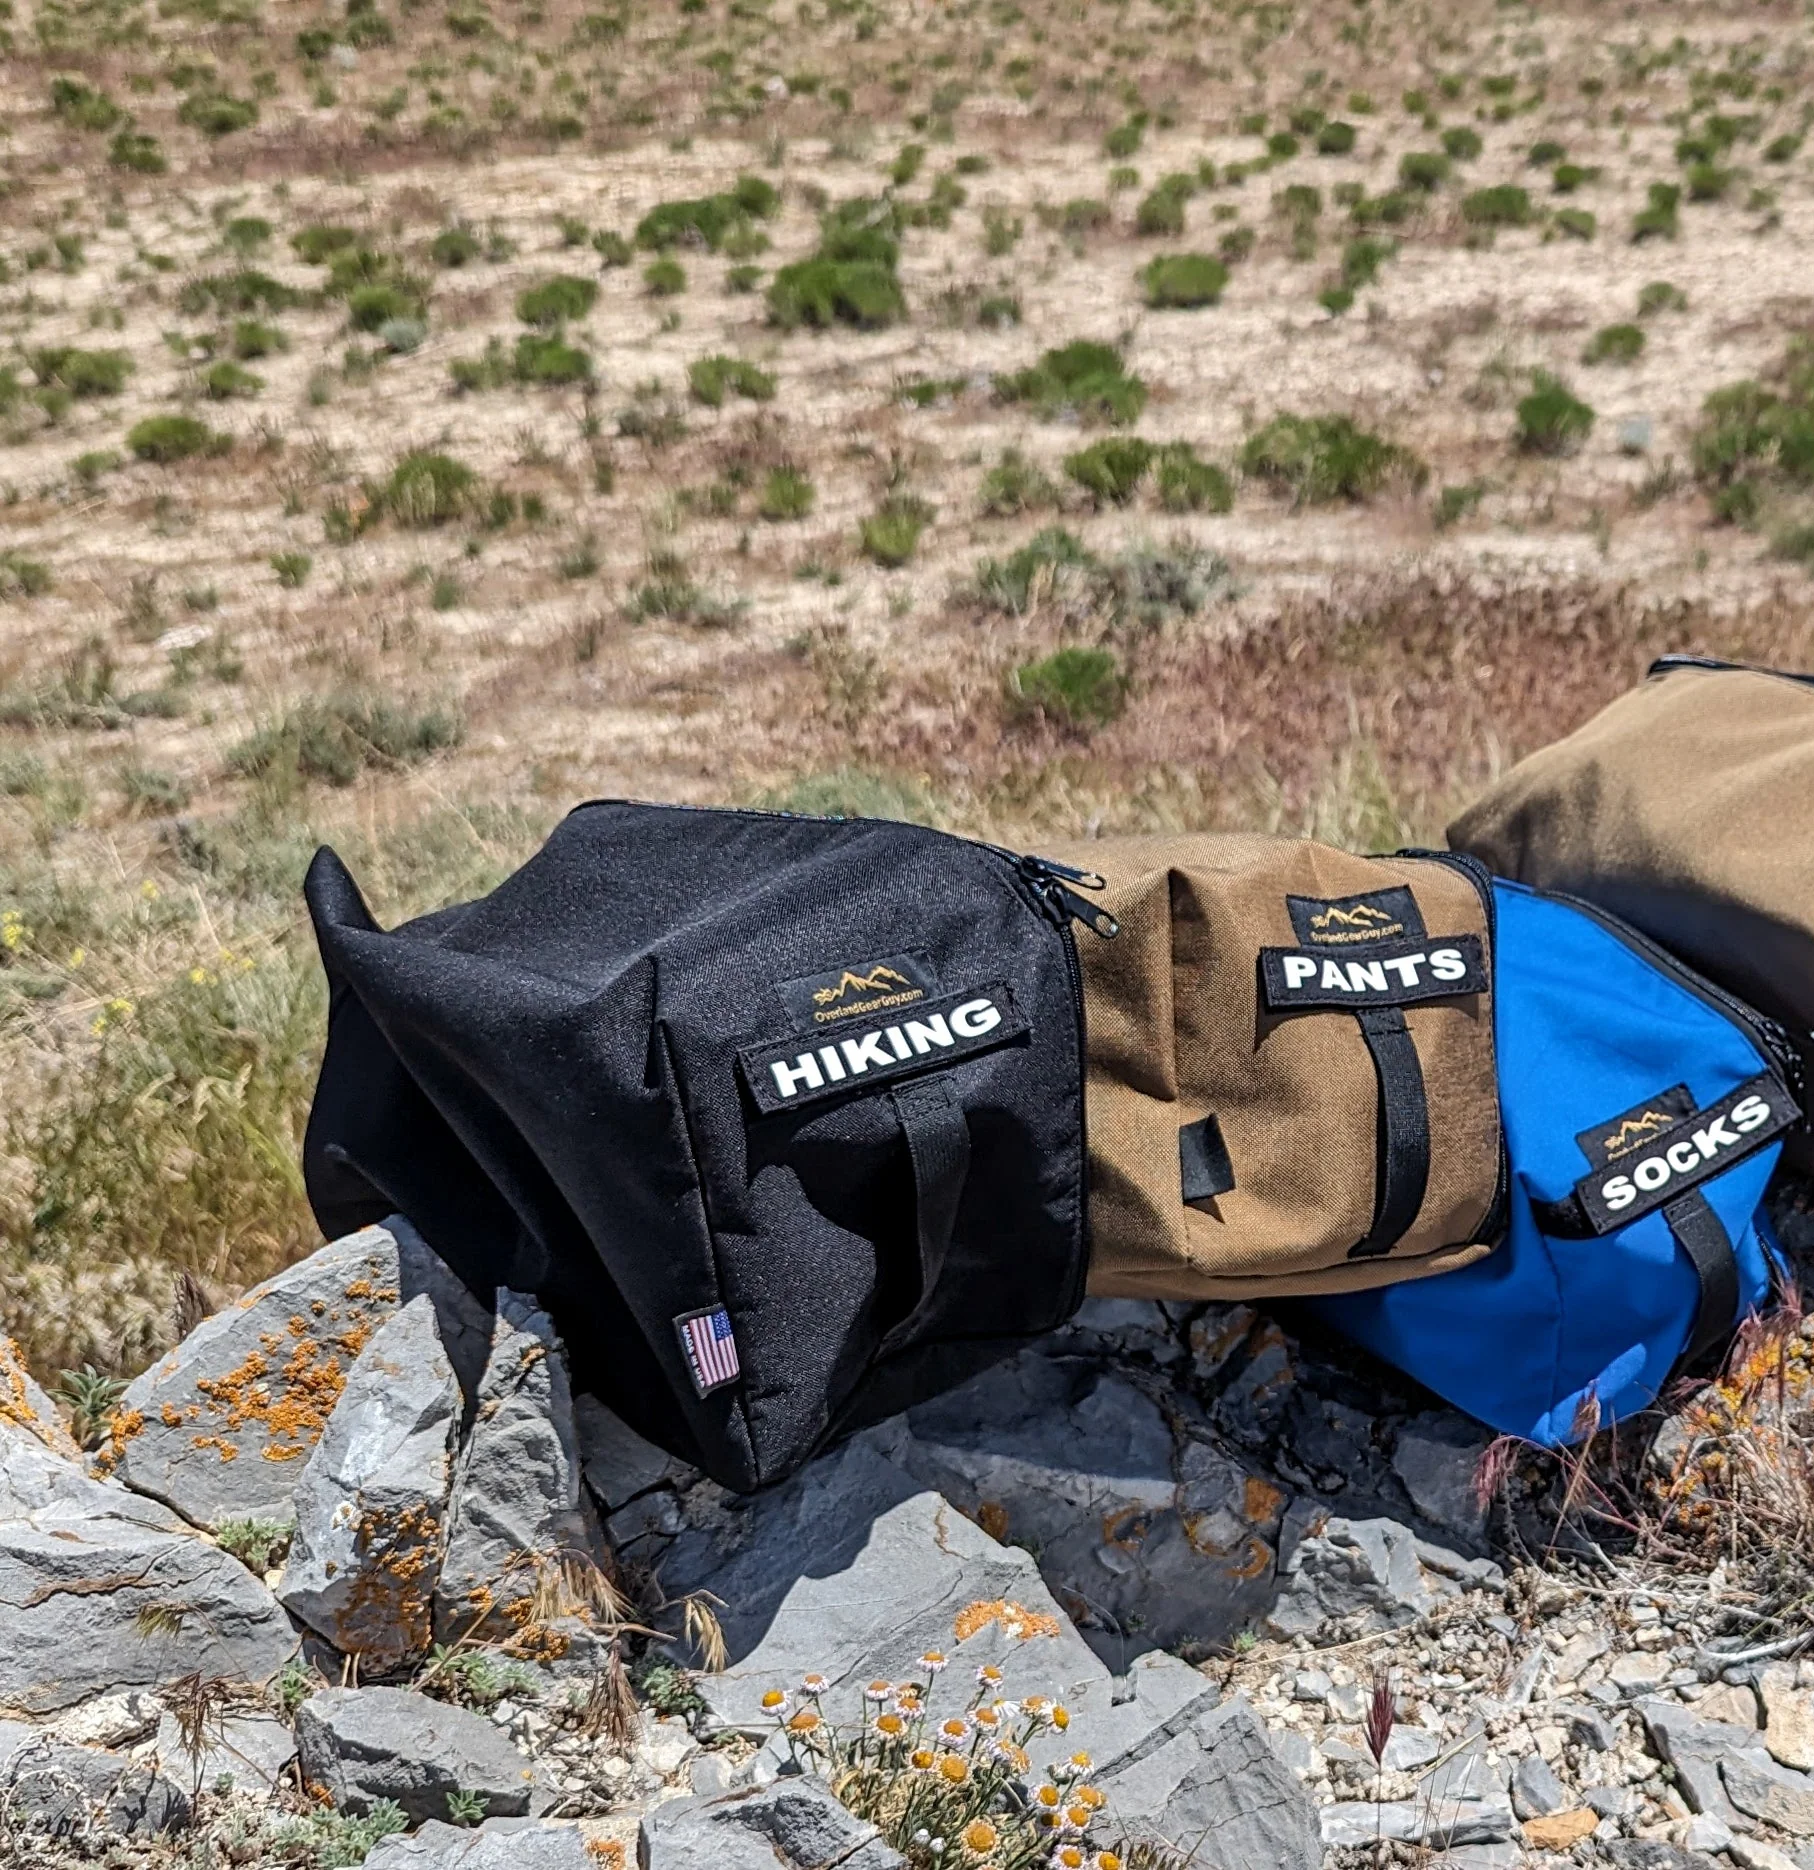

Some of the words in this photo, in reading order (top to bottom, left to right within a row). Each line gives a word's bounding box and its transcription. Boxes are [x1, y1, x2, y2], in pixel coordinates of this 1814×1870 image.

[1282, 949, 1467, 993] PANTS
[814, 988, 924, 1024] OverlandGearGuy.com
[770, 998, 1002, 1098] HIKING
[1601, 1095, 1771, 1212] SOCKS
[681, 1324, 695, 1354] MADE
